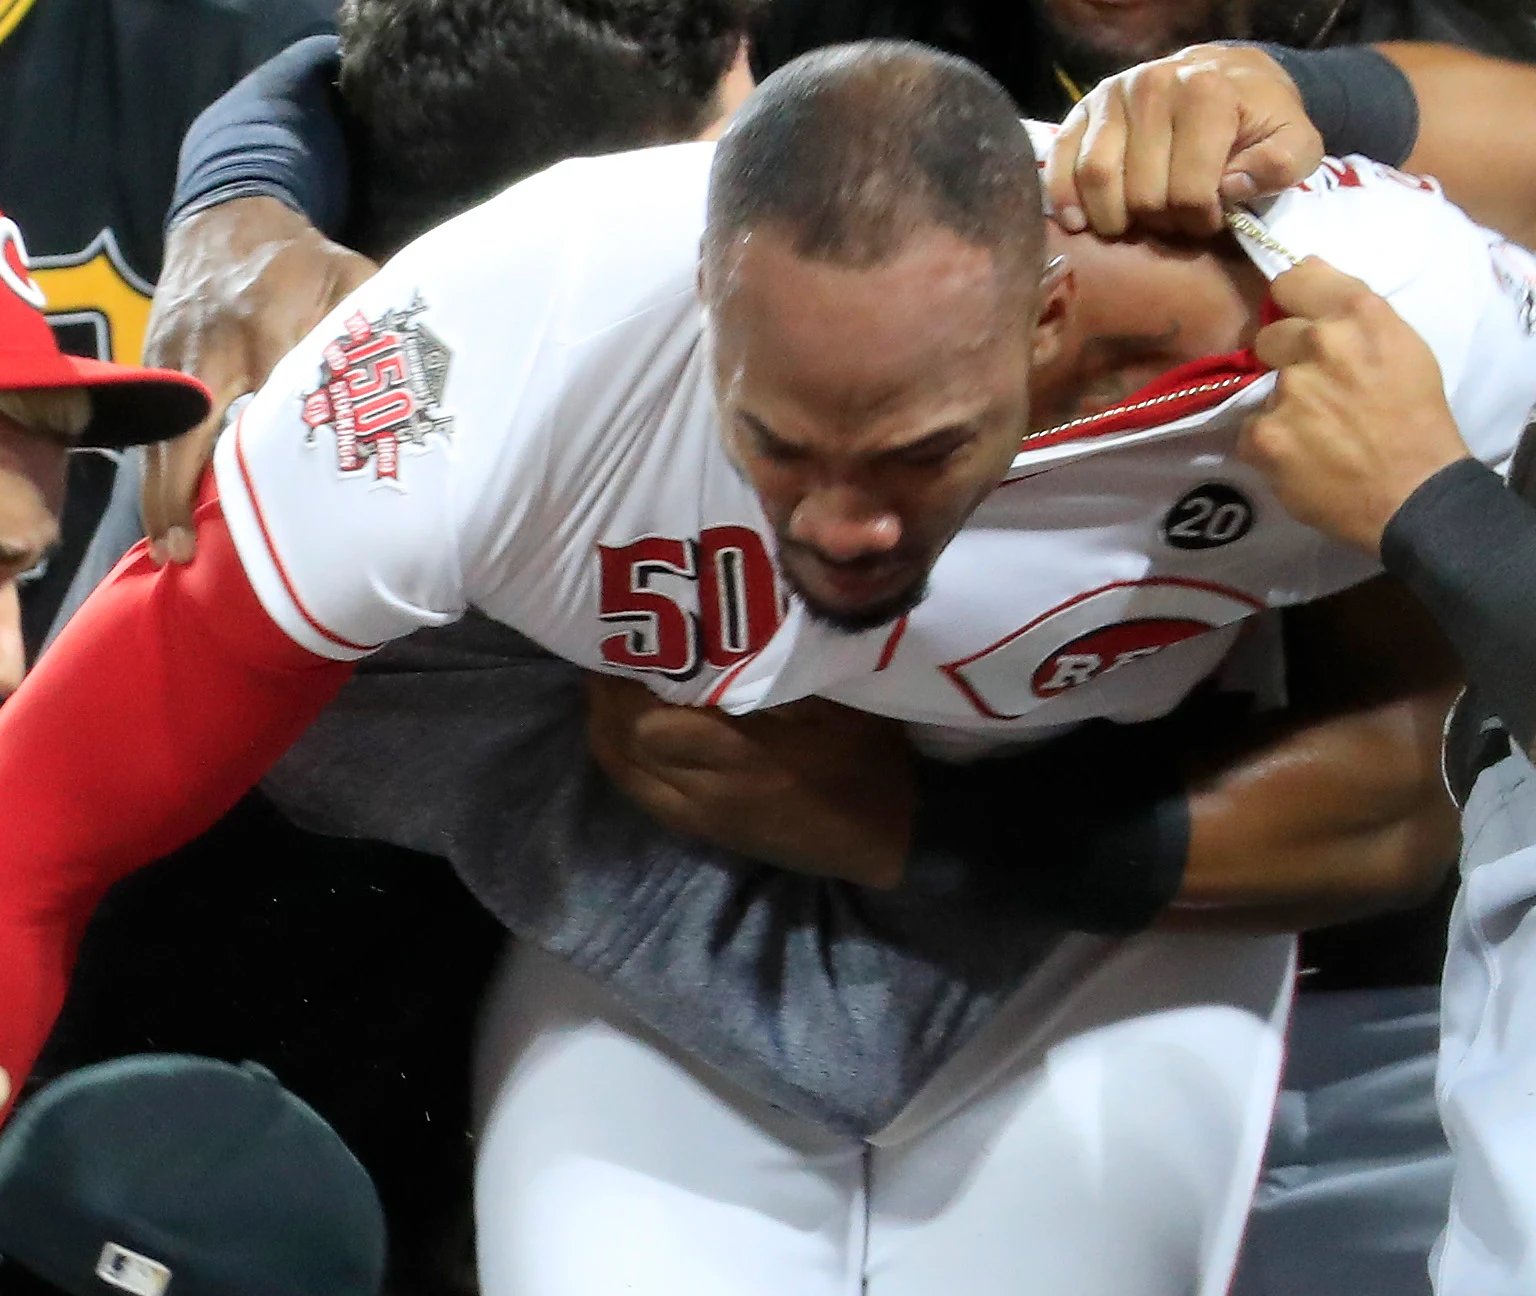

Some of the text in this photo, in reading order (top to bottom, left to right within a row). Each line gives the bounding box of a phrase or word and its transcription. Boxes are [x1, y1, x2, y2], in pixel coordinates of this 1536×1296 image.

[342, 331, 415, 437] 150
[1166, 496, 1245, 541] 20
[597, 522, 789, 682] 50
